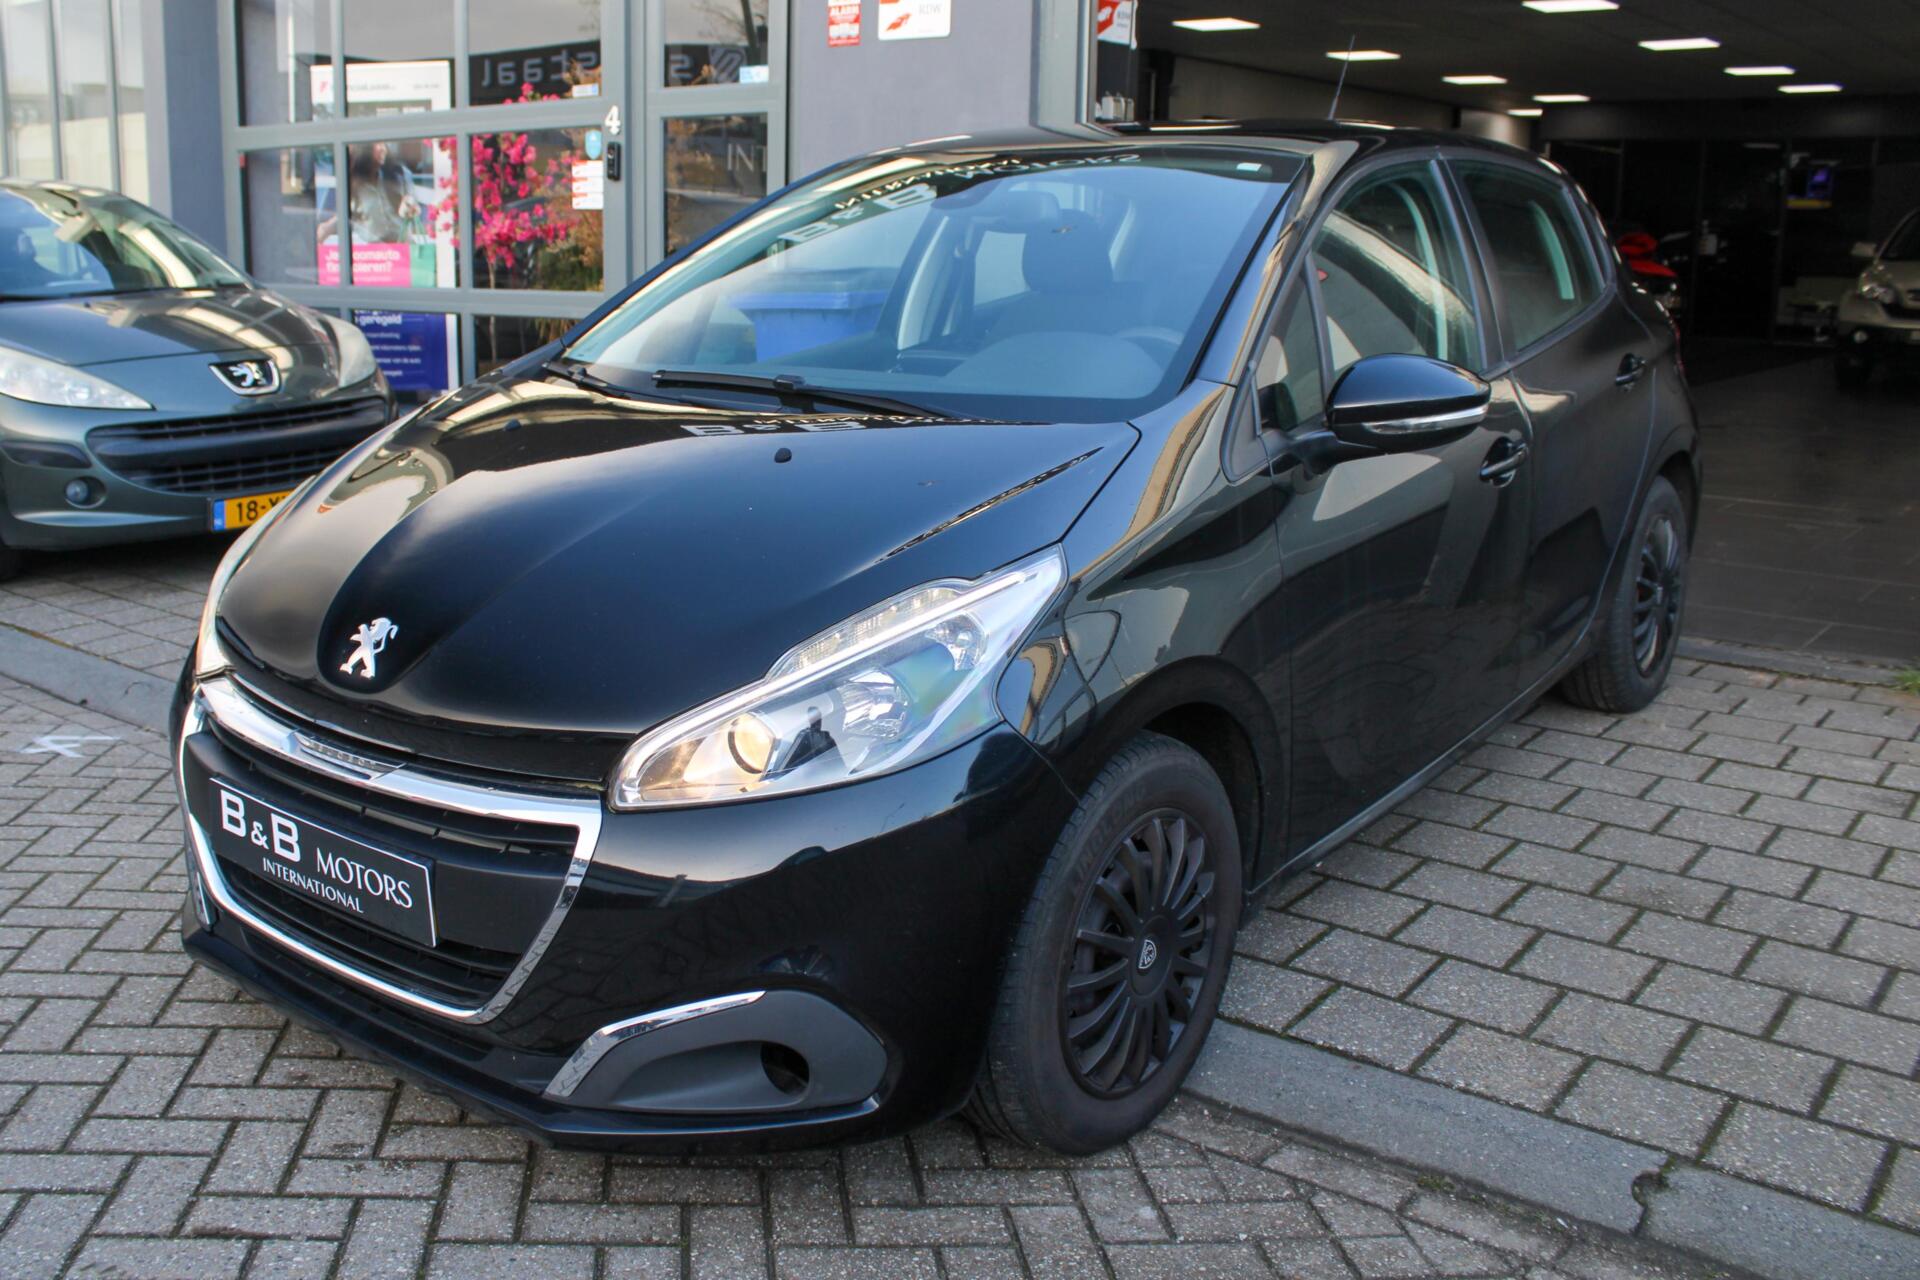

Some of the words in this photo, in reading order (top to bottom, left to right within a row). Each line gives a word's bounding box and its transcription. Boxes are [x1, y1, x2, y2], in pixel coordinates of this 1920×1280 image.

[604, 104, 621, 135] 4
[220, 789, 301, 863] B&B
[316, 847, 413, 909] MOTORS
[262, 857, 364, 914] INTERNATIONAL
